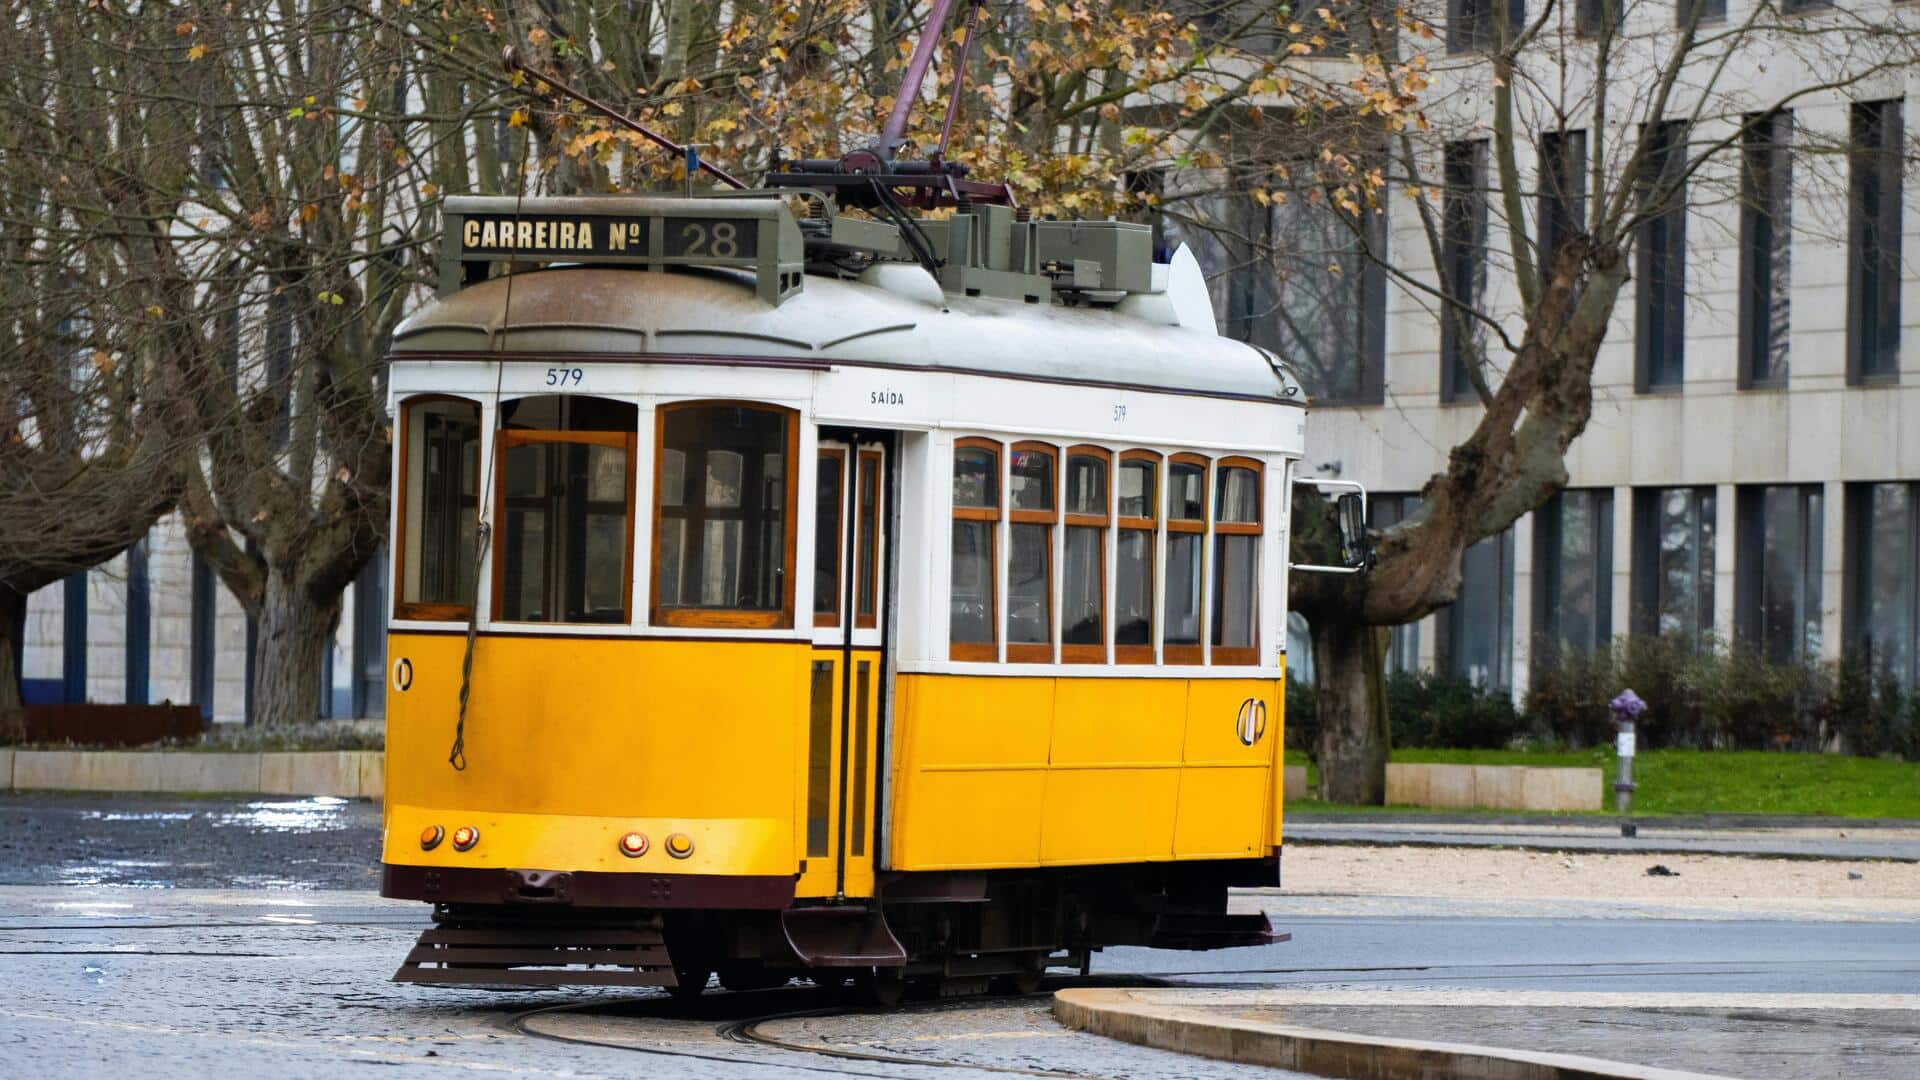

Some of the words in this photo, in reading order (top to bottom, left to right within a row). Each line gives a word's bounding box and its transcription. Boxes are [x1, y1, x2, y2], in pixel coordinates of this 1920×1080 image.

[463, 219, 593, 249] CARREIRA
[608, 222, 640, 250] Nº
[682, 222, 737, 257] 28
[546, 368, 583, 386] 579
[870, 387, 904, 406] SAÍDA
[1113, 405, 1127, 423] 579
